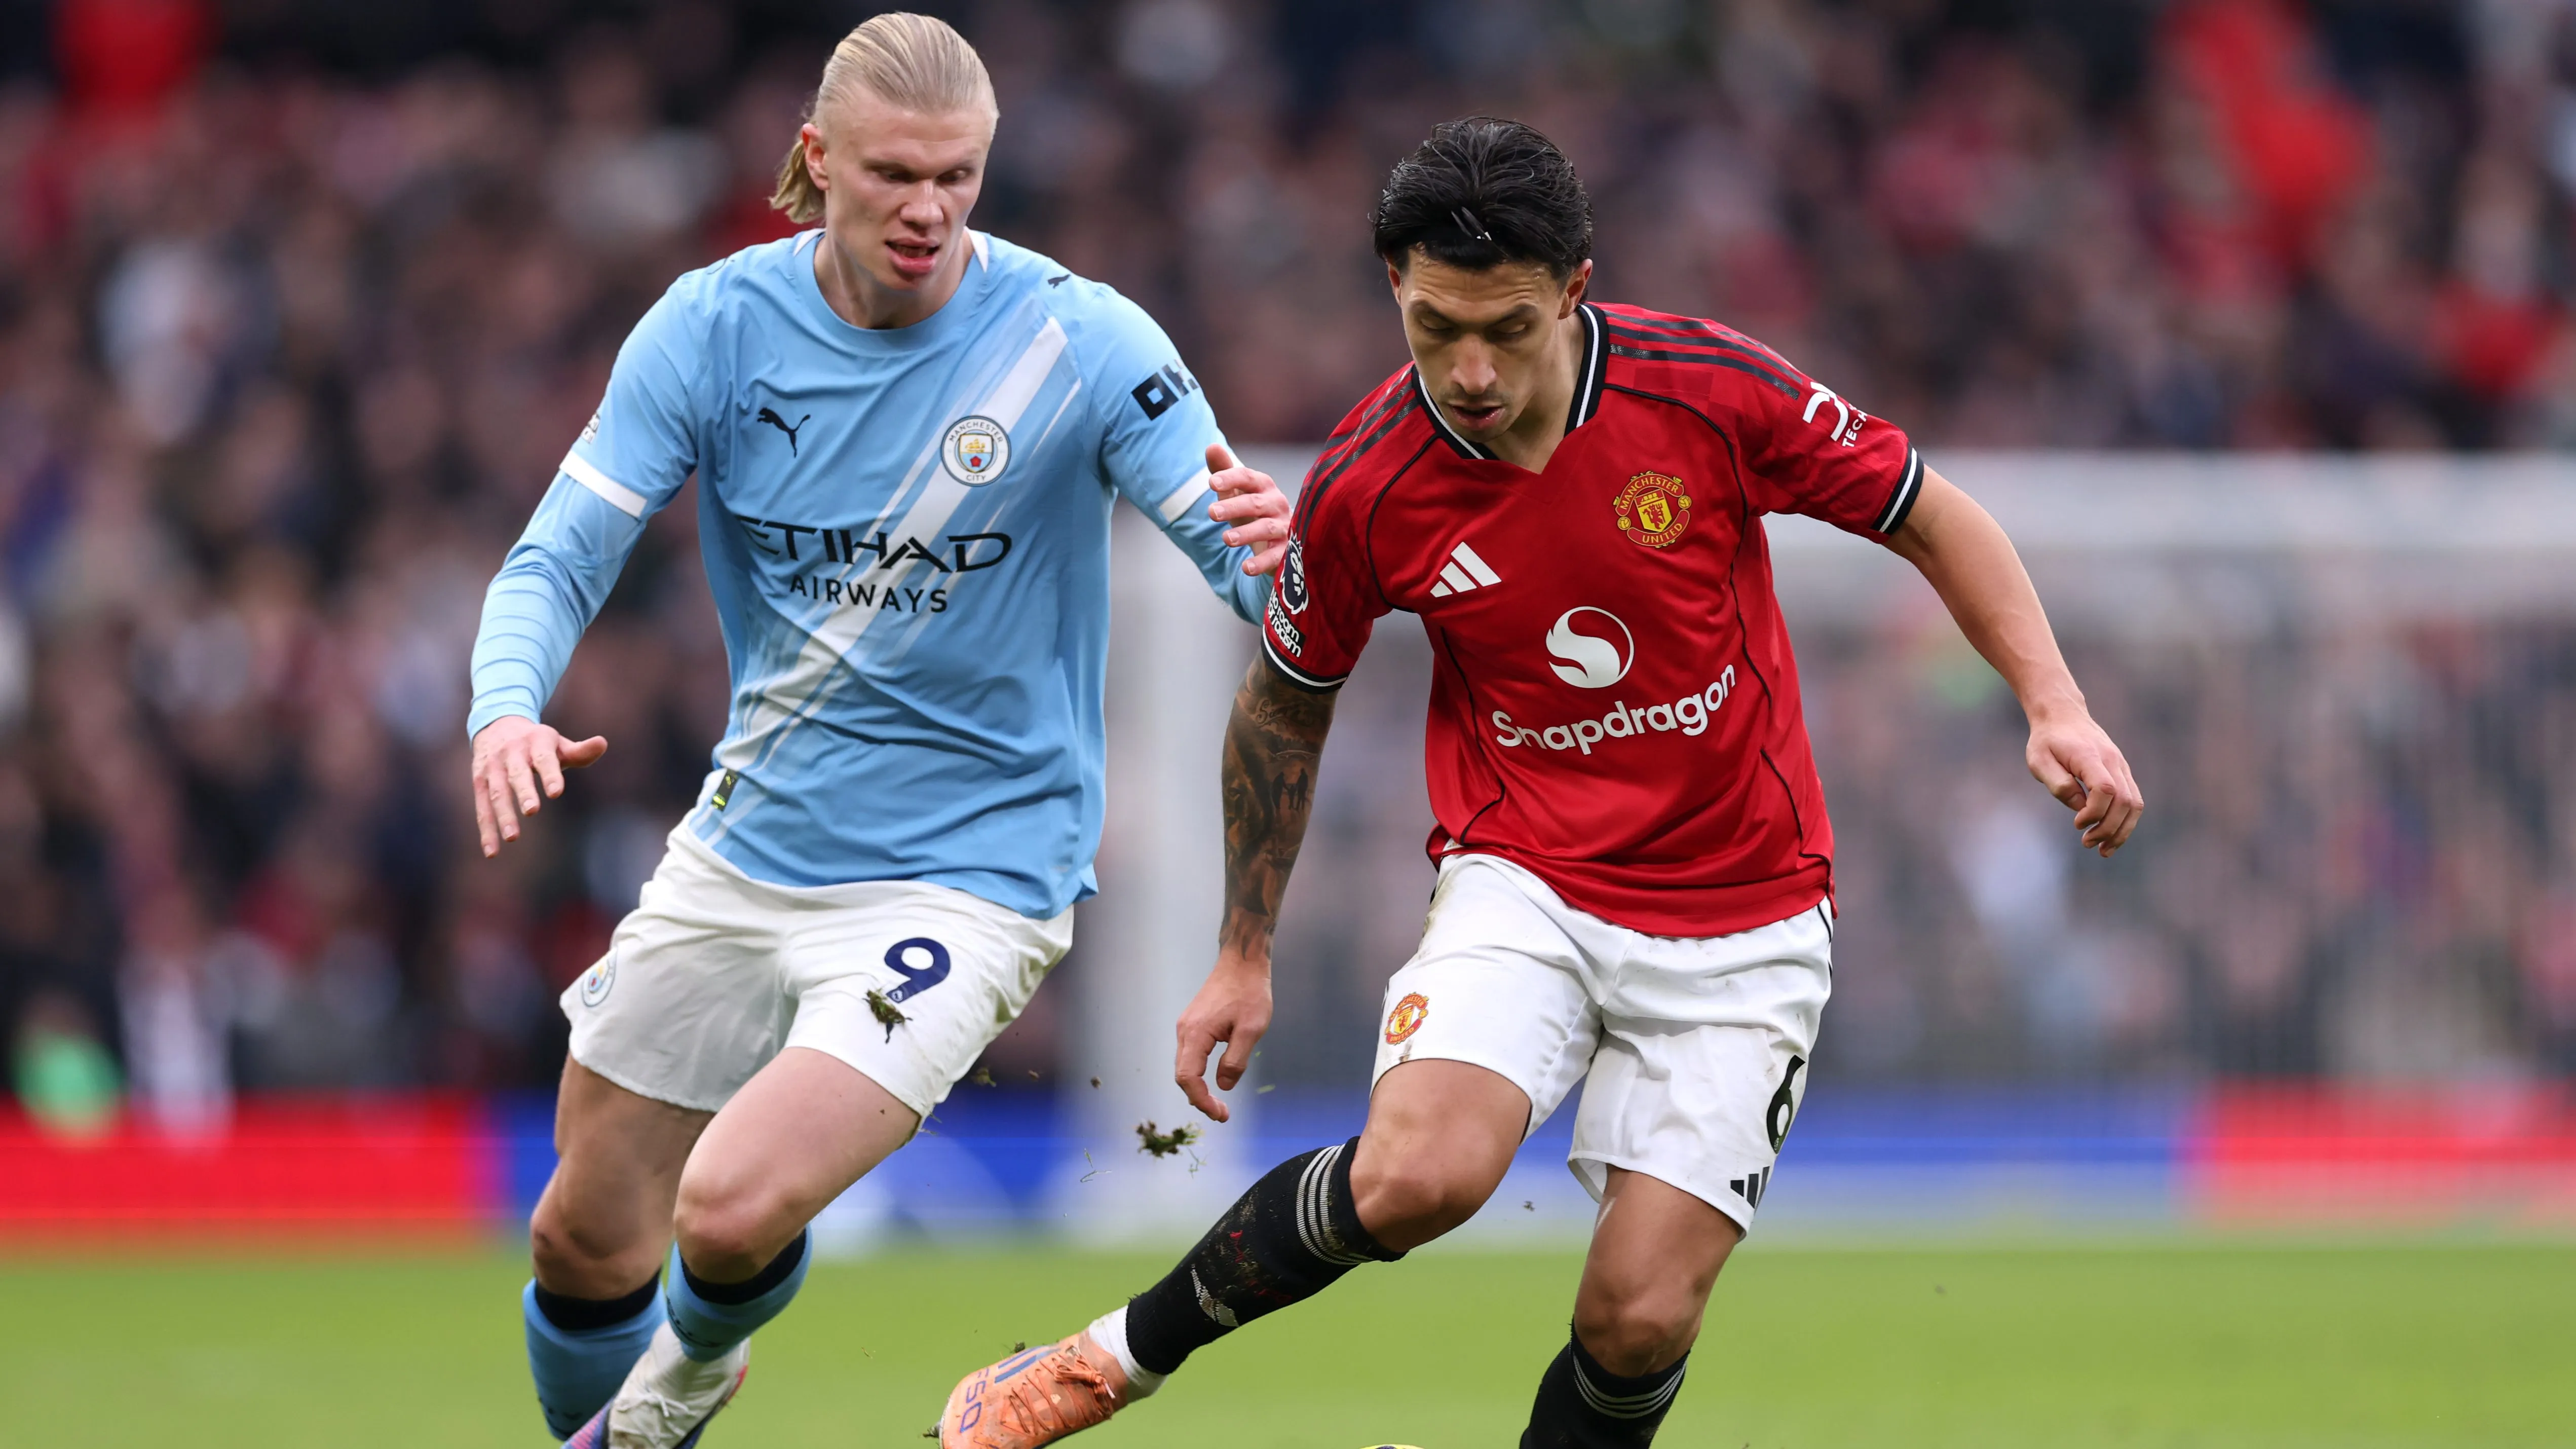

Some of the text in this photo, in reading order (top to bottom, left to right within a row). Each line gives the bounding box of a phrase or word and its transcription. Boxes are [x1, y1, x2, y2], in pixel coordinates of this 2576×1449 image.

[949, 422, 1004, 442] MANCHESTER
[1620, 476, 1679, 510] MANCHESTER
[735, 514, 1012, 573] ETIHAD
[1642, 523, 1683, 543] UNITED
[790, 574, 949, 613] AIRWAYS
[1271, 615, 1301, 658] racism
[1277, 606, 1299, 643] room
[1492, 664, 1736, 755] Snapdragon
[884, 937, 951, 1004] 9
[1767, 1055, 1806, 1155] 6
